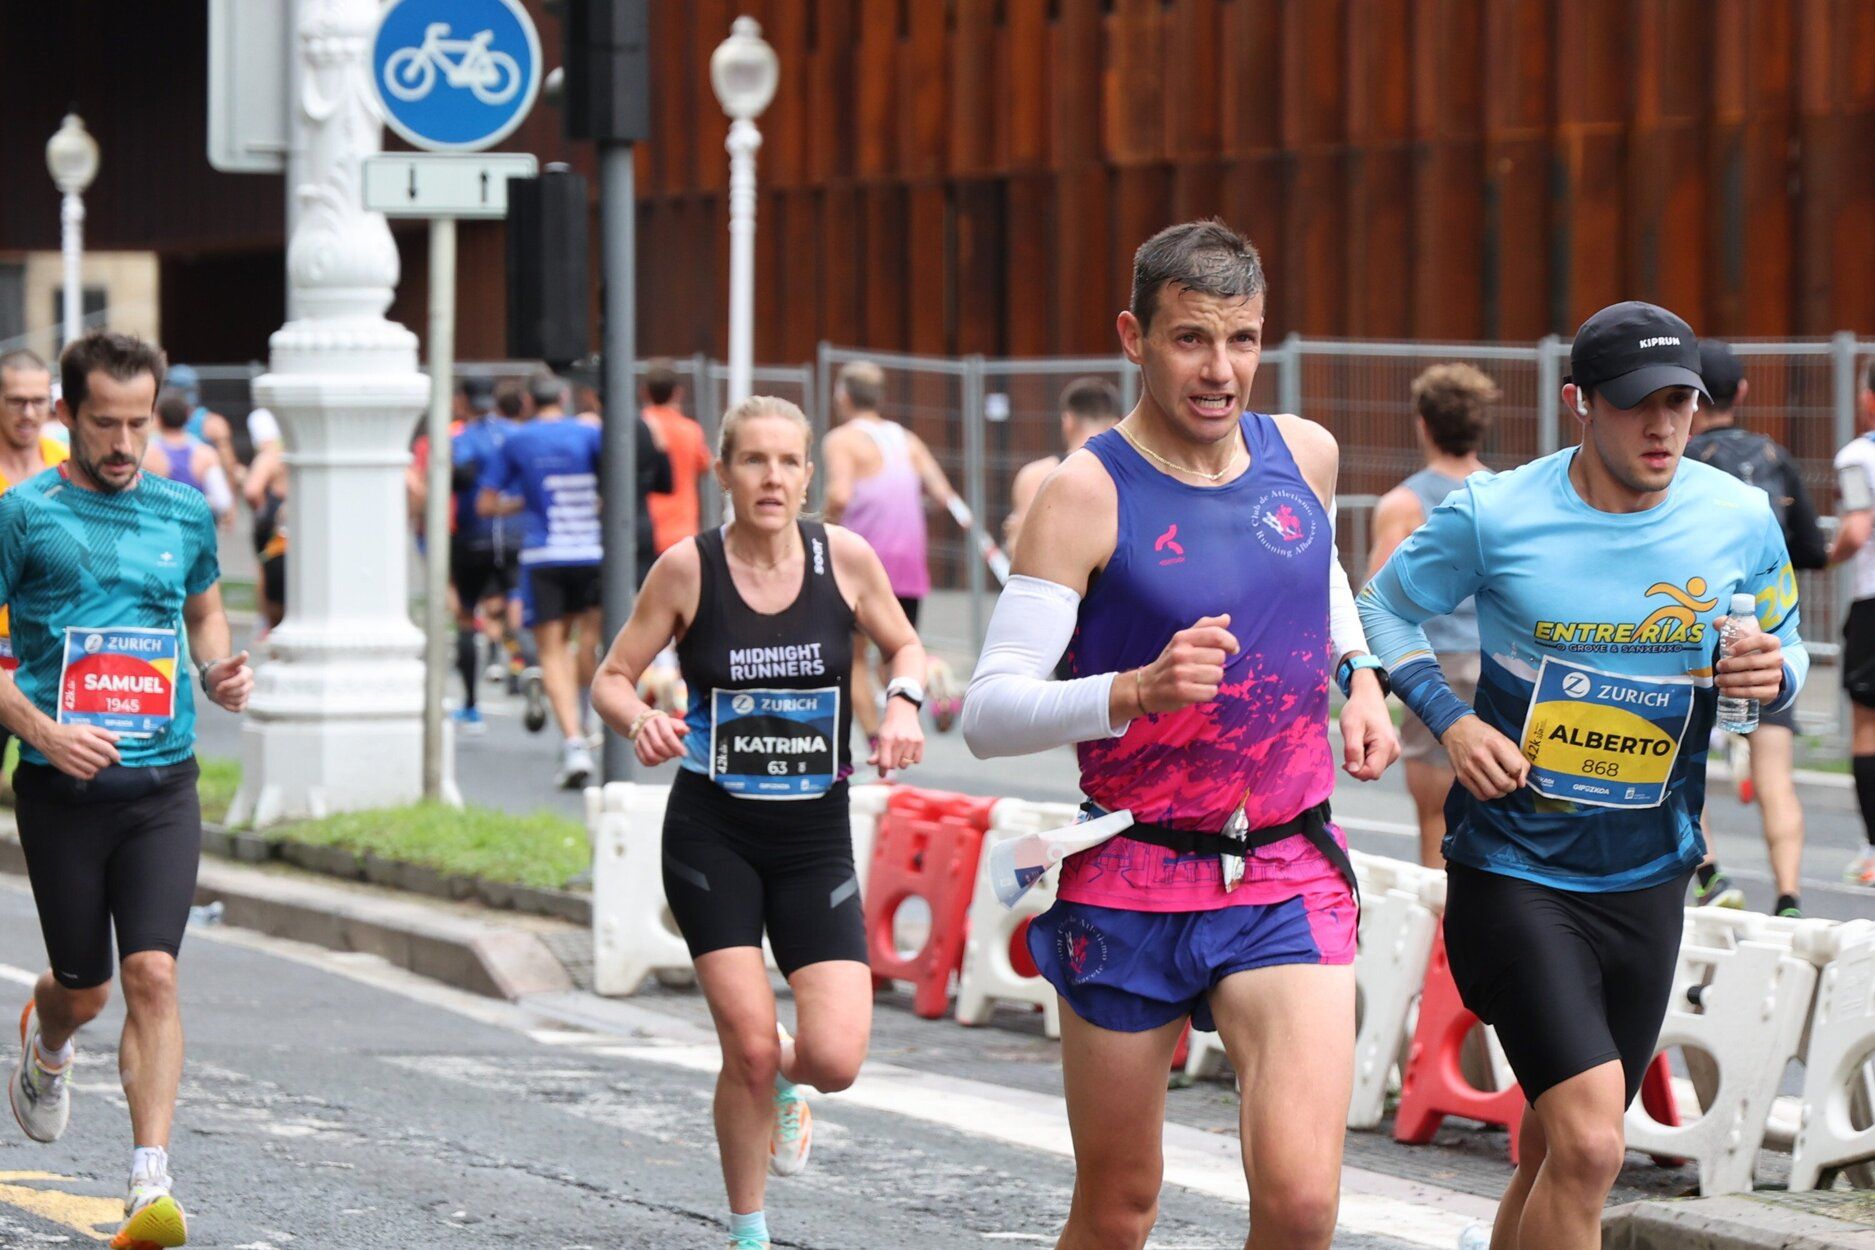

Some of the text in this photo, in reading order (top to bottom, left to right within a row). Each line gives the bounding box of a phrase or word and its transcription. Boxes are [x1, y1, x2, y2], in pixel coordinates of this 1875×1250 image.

[1639, 336, 1681, 349] KIPRUN
[1251, 489, 1313, 527] Club de Atletismo
[1256, 530, 1293, 558] Running
[1534, 618, 1706, 643] ENTRE RÍAS
[107, 636, 162, 652] ZURICH
[730, 643, 822, 666] MIDNIGHT
[1569, 643, 1608, 653] GROVE
[1610, 644, 1619, 653] &
[1622, 643, 1683, 654] SANXENXO
[731, 660, 825, 681] RUNNERS
[84, 673, 164, 694] SAMUEL
[106, 697, 140, 713] 1945
[761, 698, 818, 713] ZURICH
[1597, 684, 1670, 707] ZURICH
[734, 736, 827, 754] KATRINA
[1528, 739, 1542, 761] 42k
[1548, 724, 1670, 757] ALBERTO
[767, 760, 788, 775] 63
[1581, 759, 1619, 777] 868
